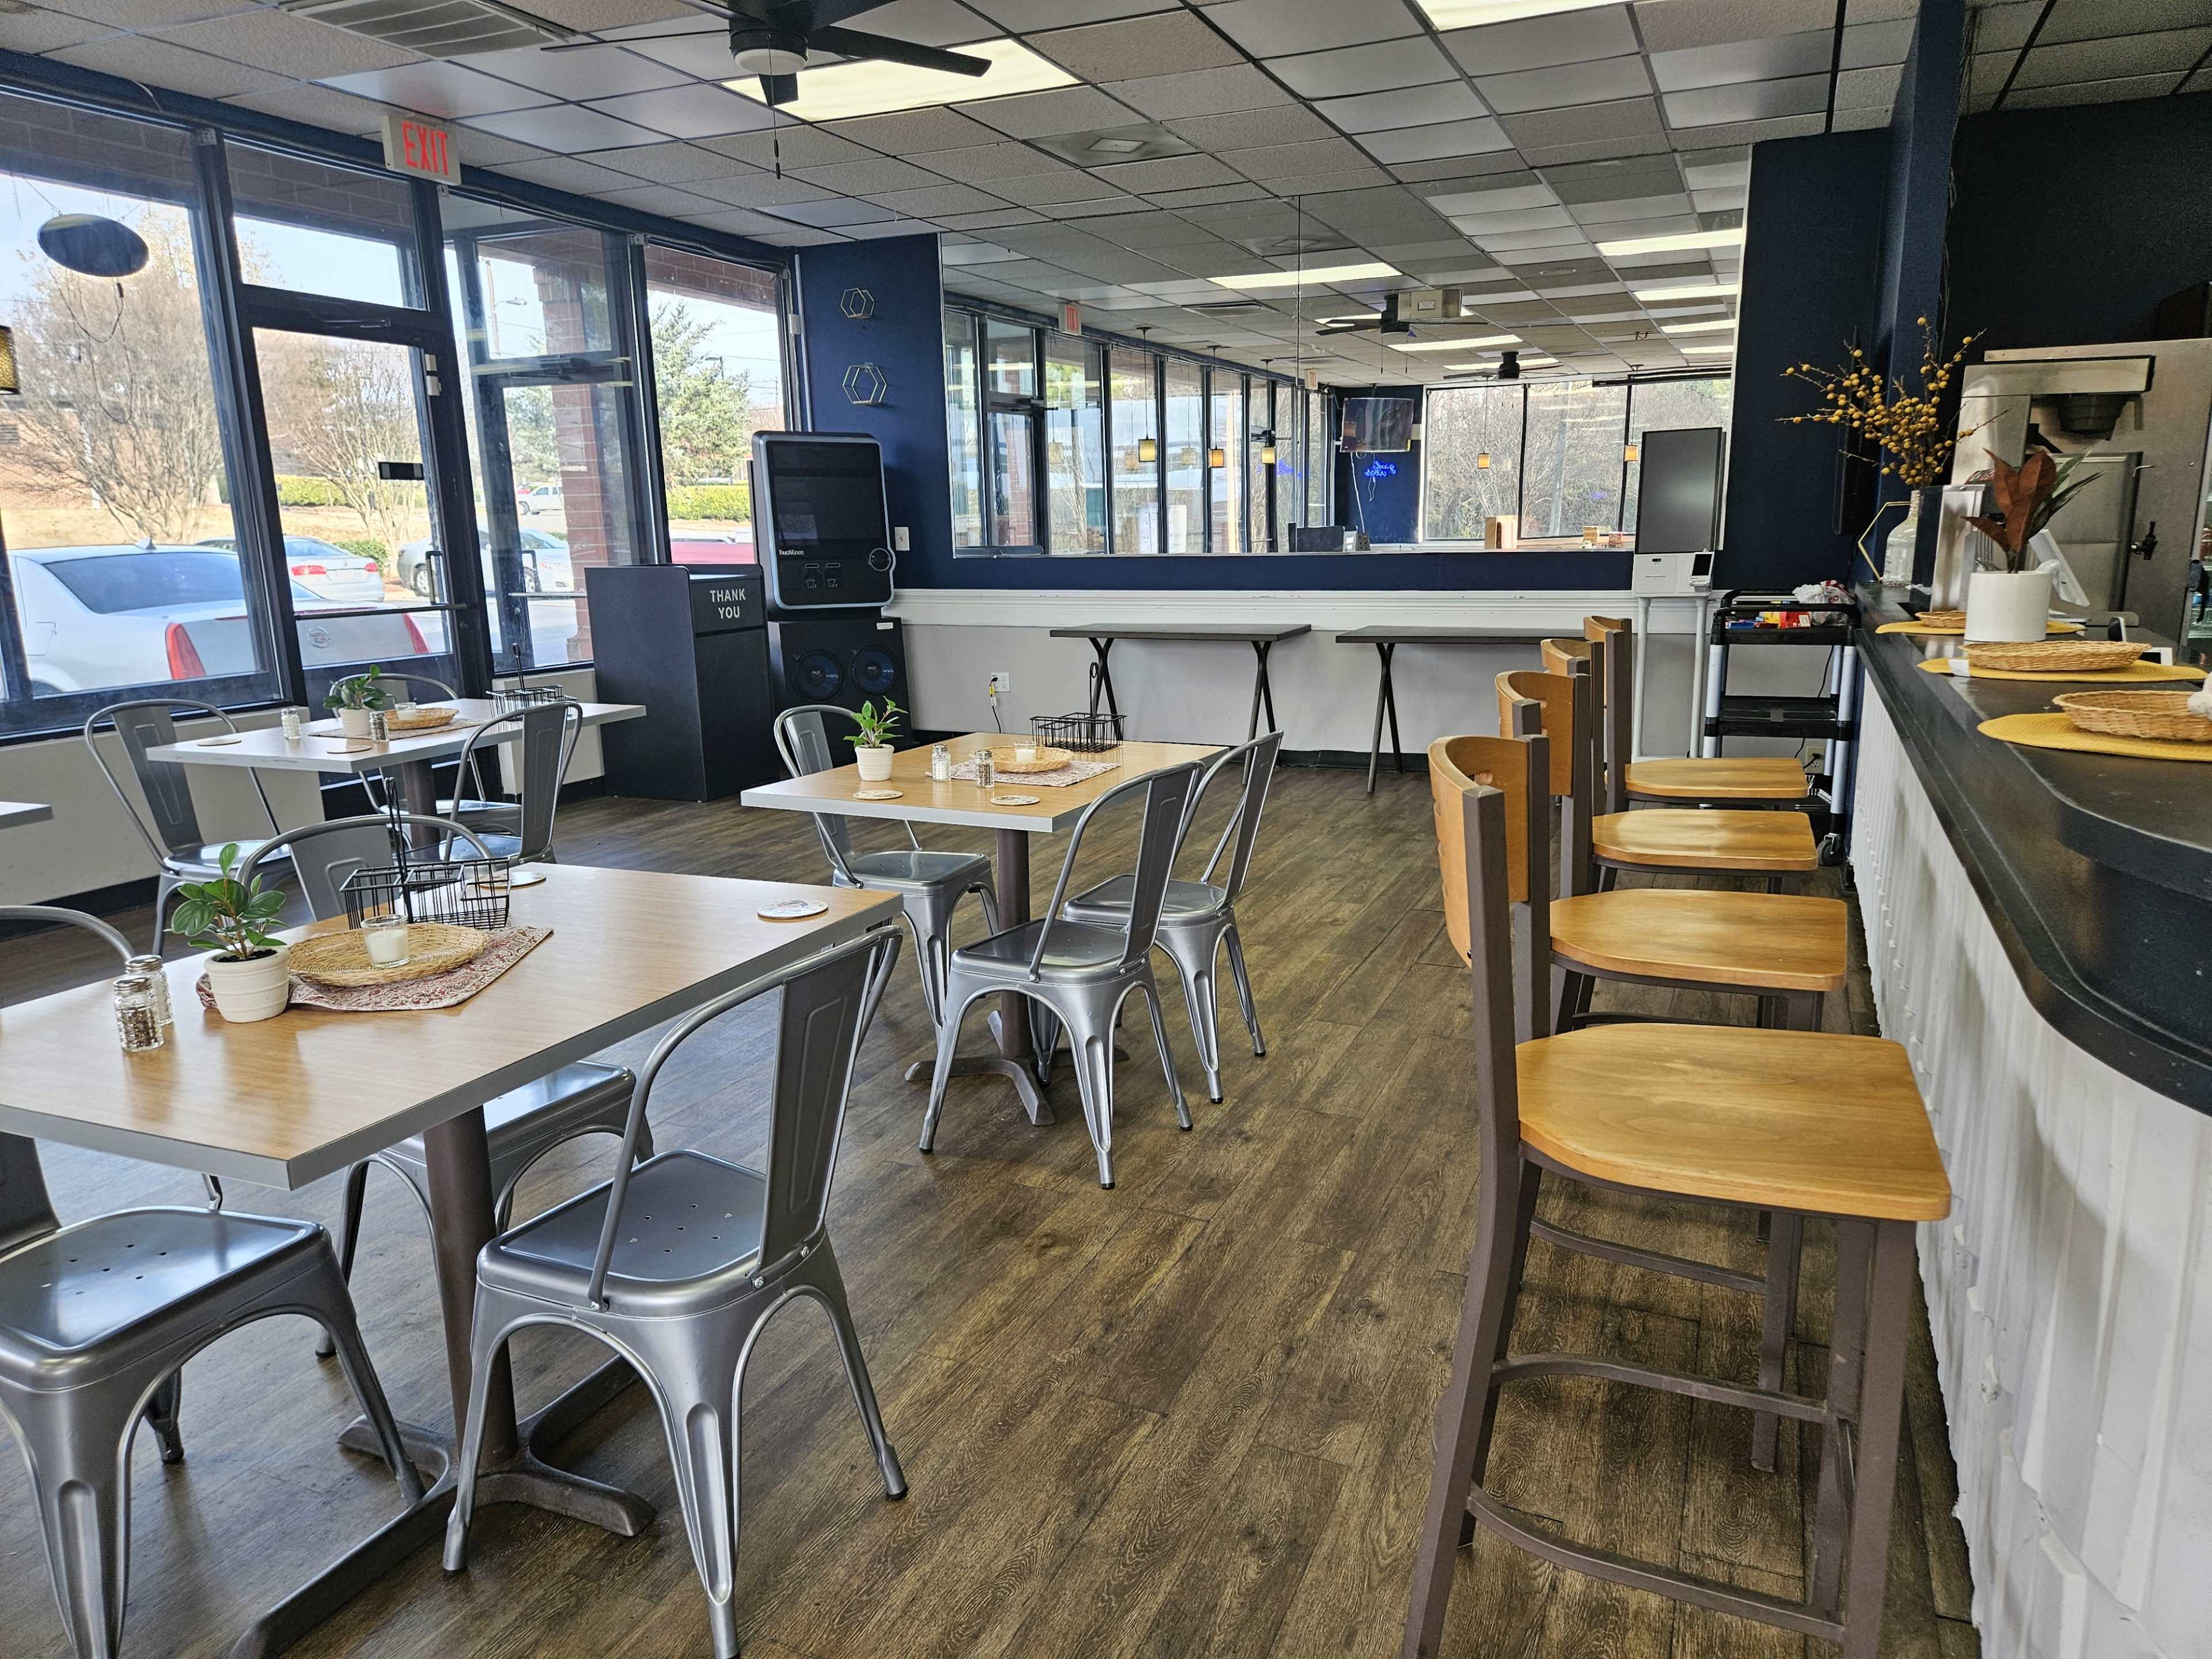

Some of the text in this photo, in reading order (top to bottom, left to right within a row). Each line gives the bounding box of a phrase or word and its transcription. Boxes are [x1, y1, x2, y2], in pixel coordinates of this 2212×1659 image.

[402, 120, 449, 176] EXIT
[709, 588, 747, 603] THANK
[717, 605, 740, 619] YOU
